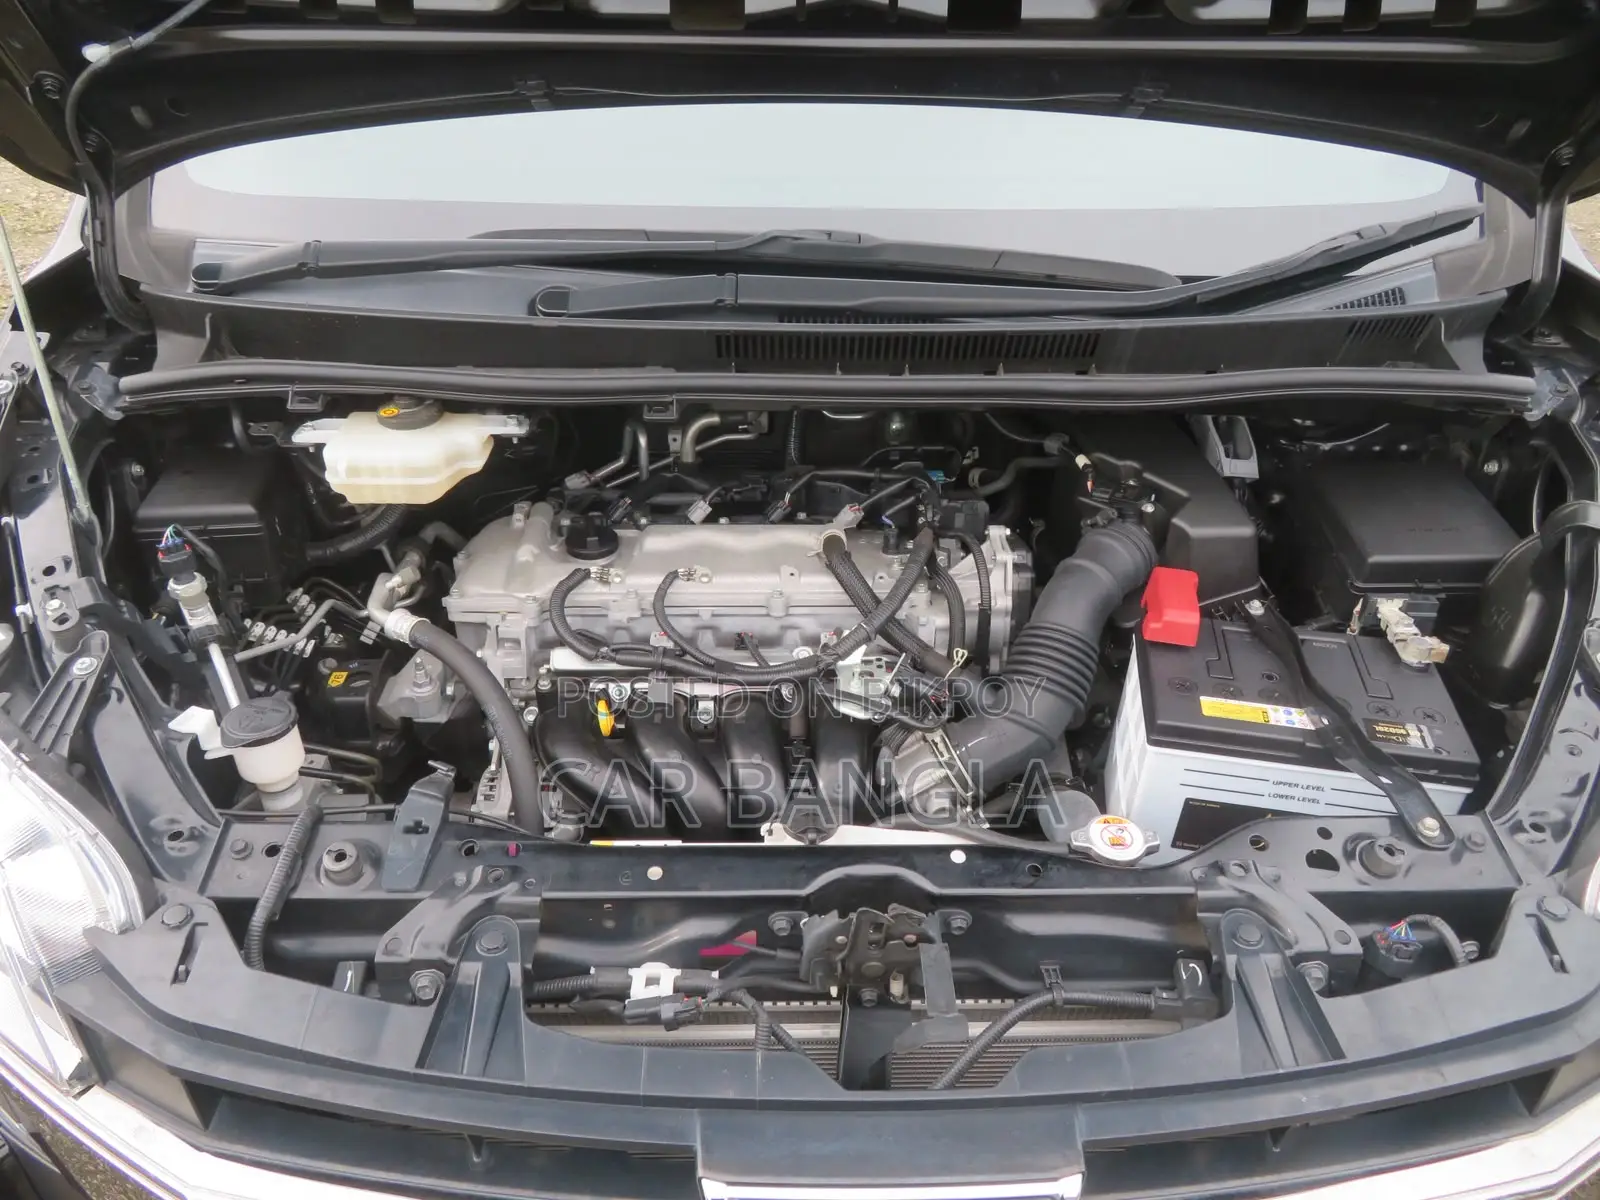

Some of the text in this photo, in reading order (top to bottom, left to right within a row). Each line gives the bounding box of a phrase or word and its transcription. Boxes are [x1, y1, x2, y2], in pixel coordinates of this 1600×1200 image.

[1272, 780, 1326, 792] UPPER LEVEL
[1268, 792, 1321, 805] LOWER LEVEL
